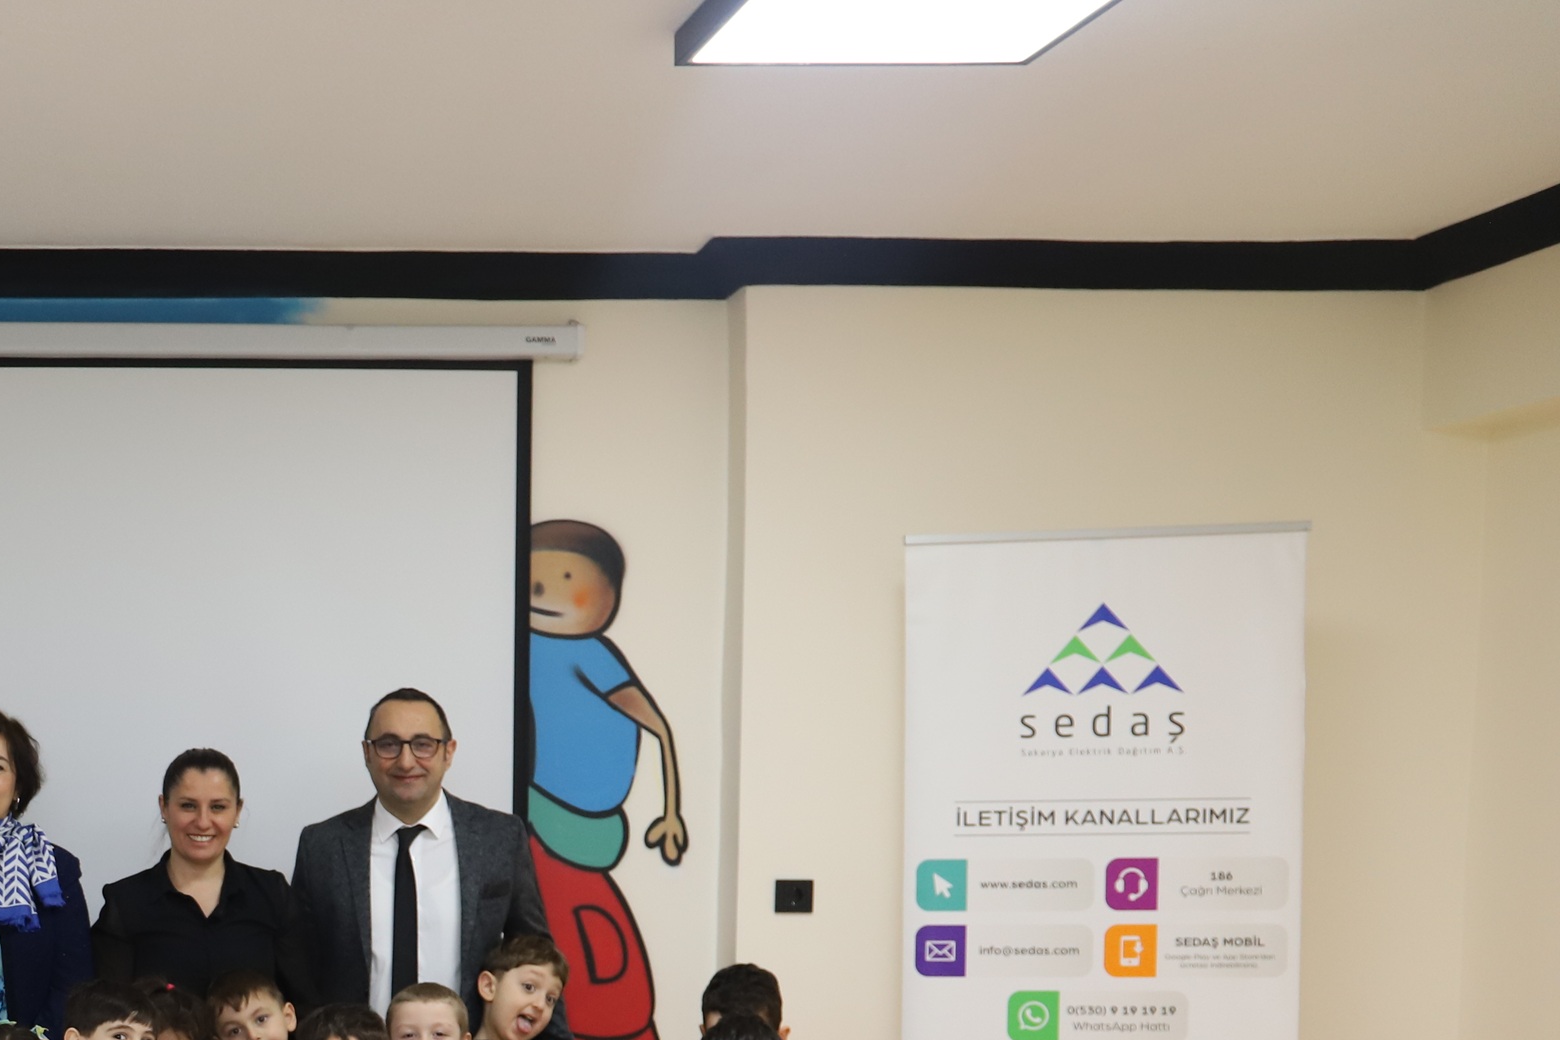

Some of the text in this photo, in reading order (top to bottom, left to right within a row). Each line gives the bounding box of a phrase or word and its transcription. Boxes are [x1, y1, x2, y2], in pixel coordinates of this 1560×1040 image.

[1020, 704, 1186, 743] sedaş
[955, 806, 1251, 830] İLETİŞİM KANALLARIMIZ
[1210, 871, 1233, 881] 186
[980, 879, 1078, 890] www.sedas.com
[1216, 886, 1263, 896] Merkezi
[1175, 935, 1265, 949] SEDAŞ MOBİL
[979, 945, 1080, 957] info@sedas.com
[1122, 1005, 1137, 1016] 19
[1142, 1005, 1157, 1016] 19
[1161, 1005, 1177, 1016] 19
[1073, 1021, 1137, 1032] WhatsApp
